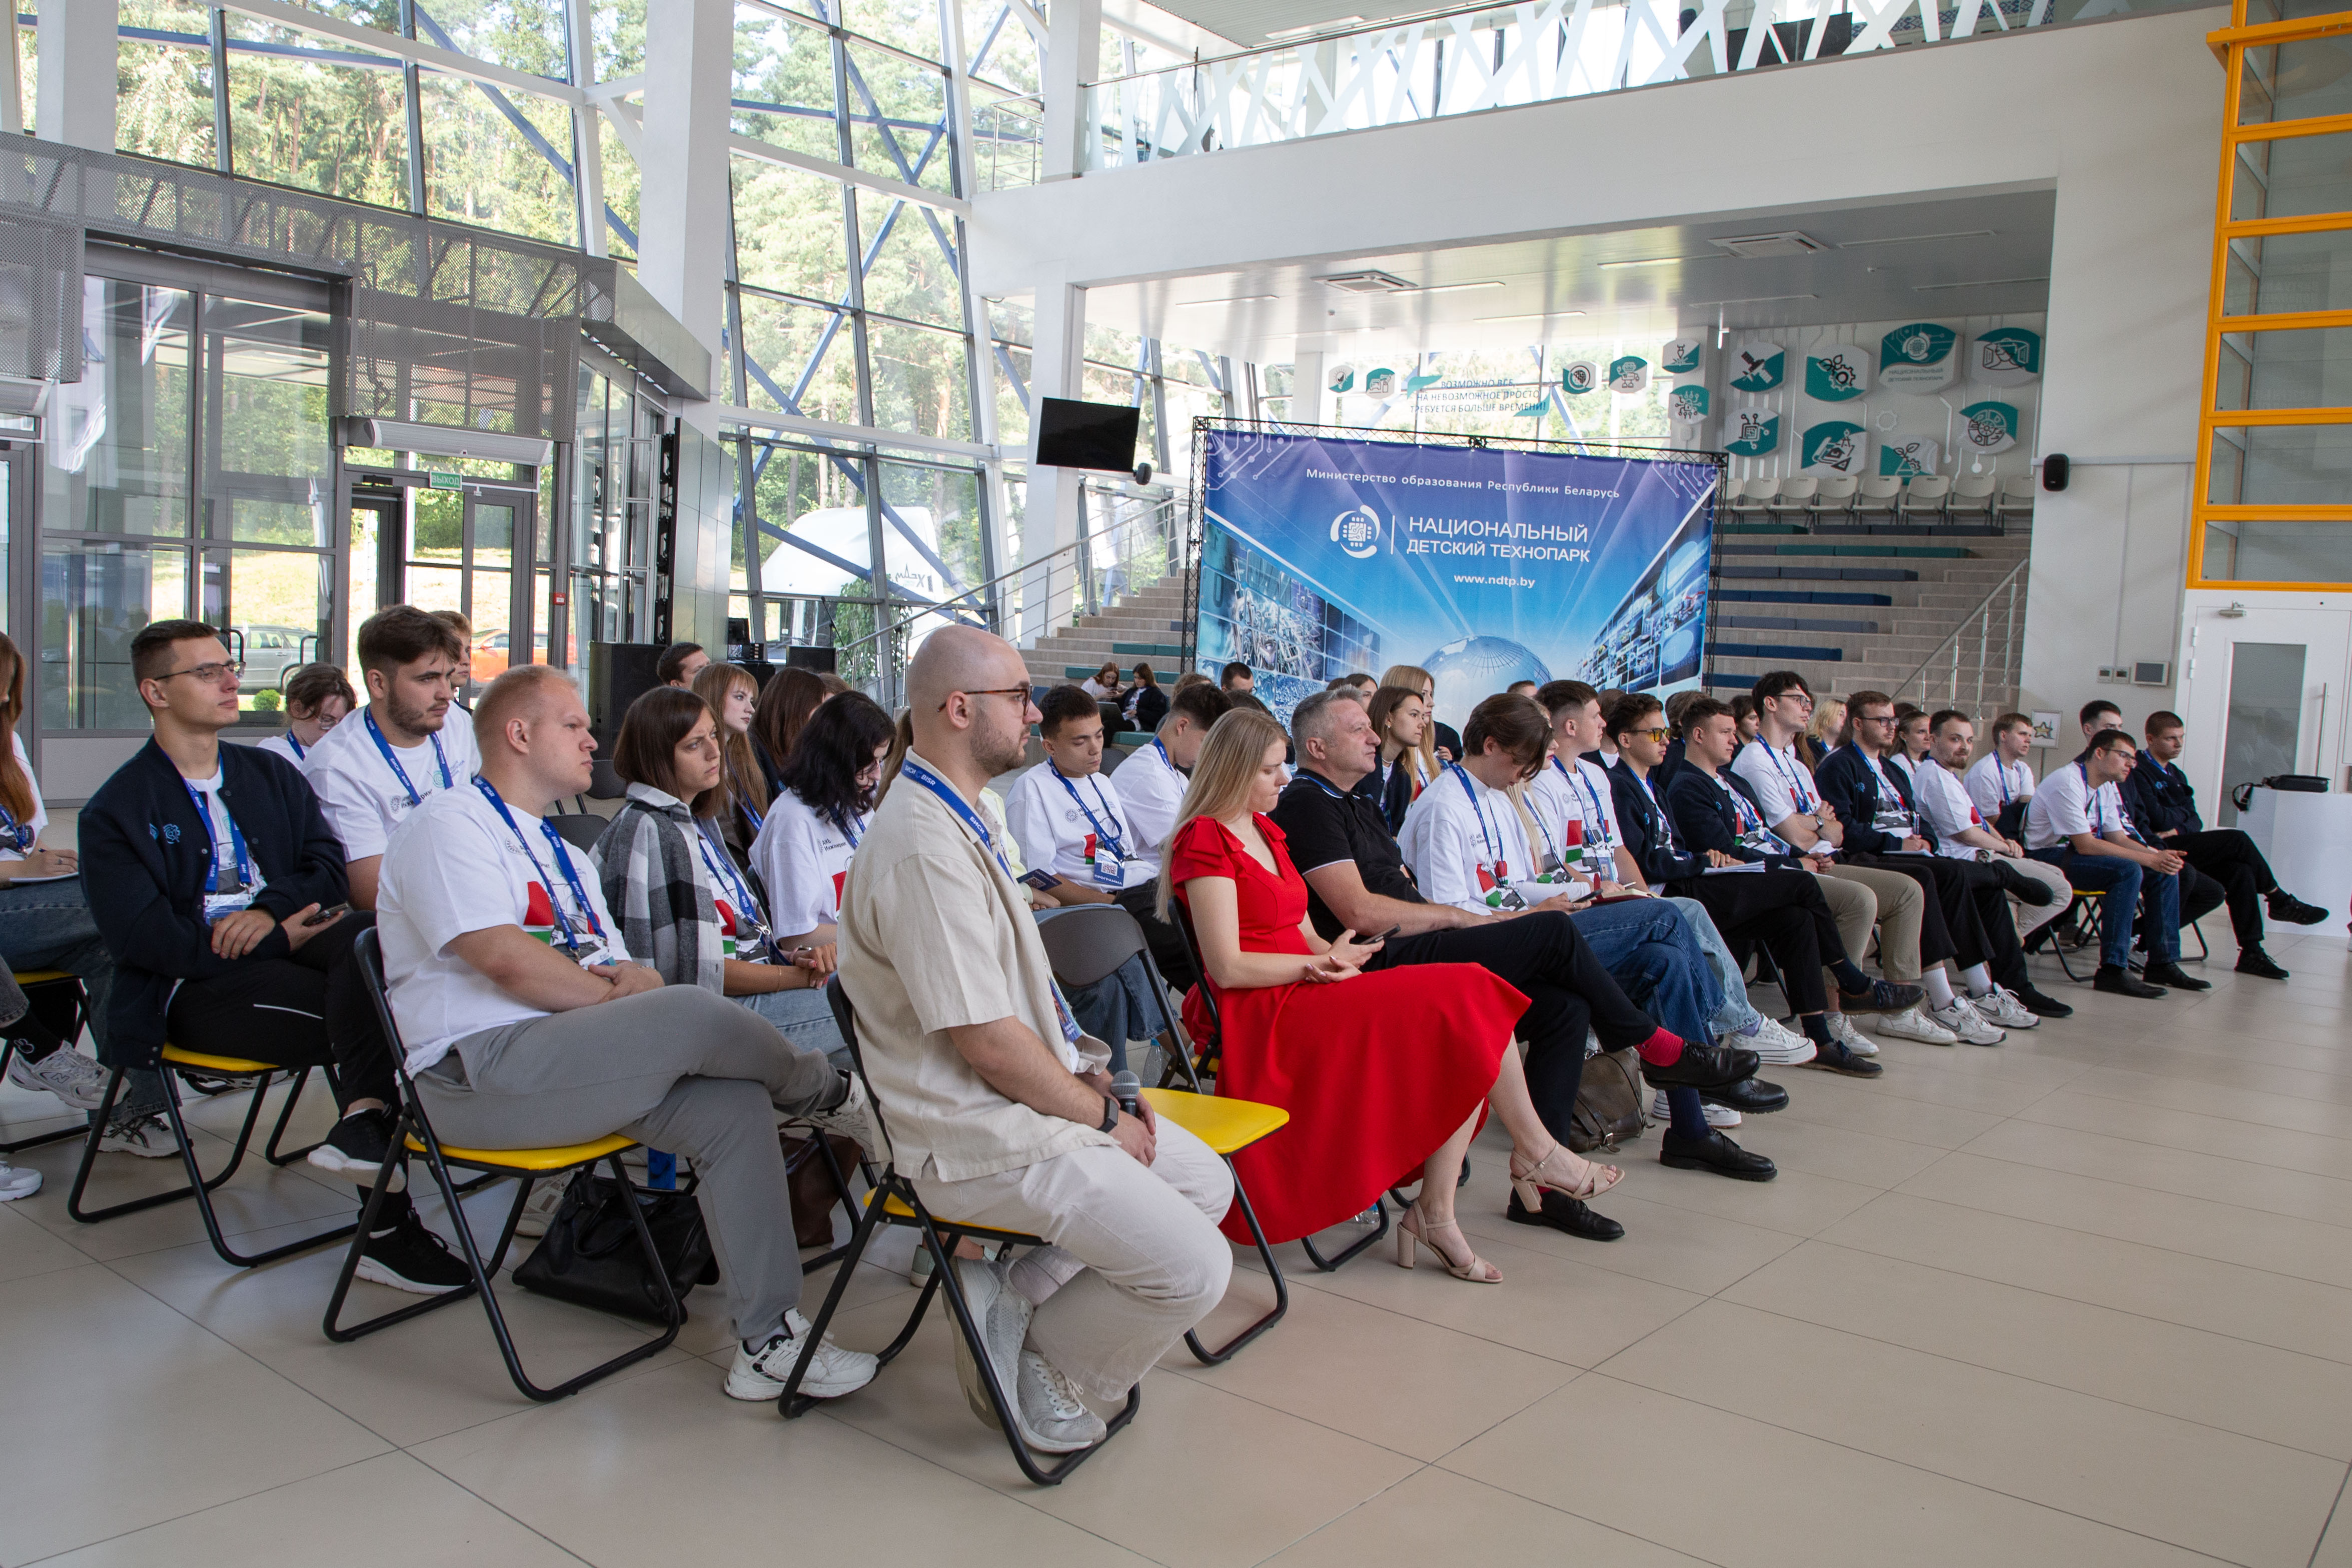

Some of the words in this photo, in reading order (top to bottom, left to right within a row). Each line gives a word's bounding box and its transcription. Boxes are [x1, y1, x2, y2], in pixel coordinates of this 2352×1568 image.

[1441, 379, 1495, 389] ВОЗМОЖНО
[1417, 393, 1429, 401] НА
[1431, 391, 1501, 401] НЕВОЗМОЖНОЕ
[1503, 390, 1540, 400] ПРОСТО
[1410, 405, 1456, 413] ТРЕБУЕТСЯ
[1458, 403, 1496, 413] БОЛЬШЕ
[1499, 402, 1546, 411] ВРЕМЕНИ!
[432, 475, 460, 487] ВЫХОД
[1306, 468, 1396, 484] Министерство
[1402, 475, 1482, 490] образования
[1488, 480, 1559, 494] Республики
[1565, 485, 1620, 499] Беларусь
[1409, 516, 1588, 543] НАЦИОНАЛЬНЫЙ
[1406, 539, 1486, 557] ДЕТСКИЙ
[1490, 544, 1591, 563] ТЕХНОПАРК
[1454, 574, 1536, 589] www.ndtp.by
[921, 774, 936, 786] BISR
[969, 816, 985, 834] БИСИ
[551, 836, 561, 848] BISR
[1094, 874, 1122, 886] ПРОГРАММА
[572, 881, 583, 896] БИСИ
